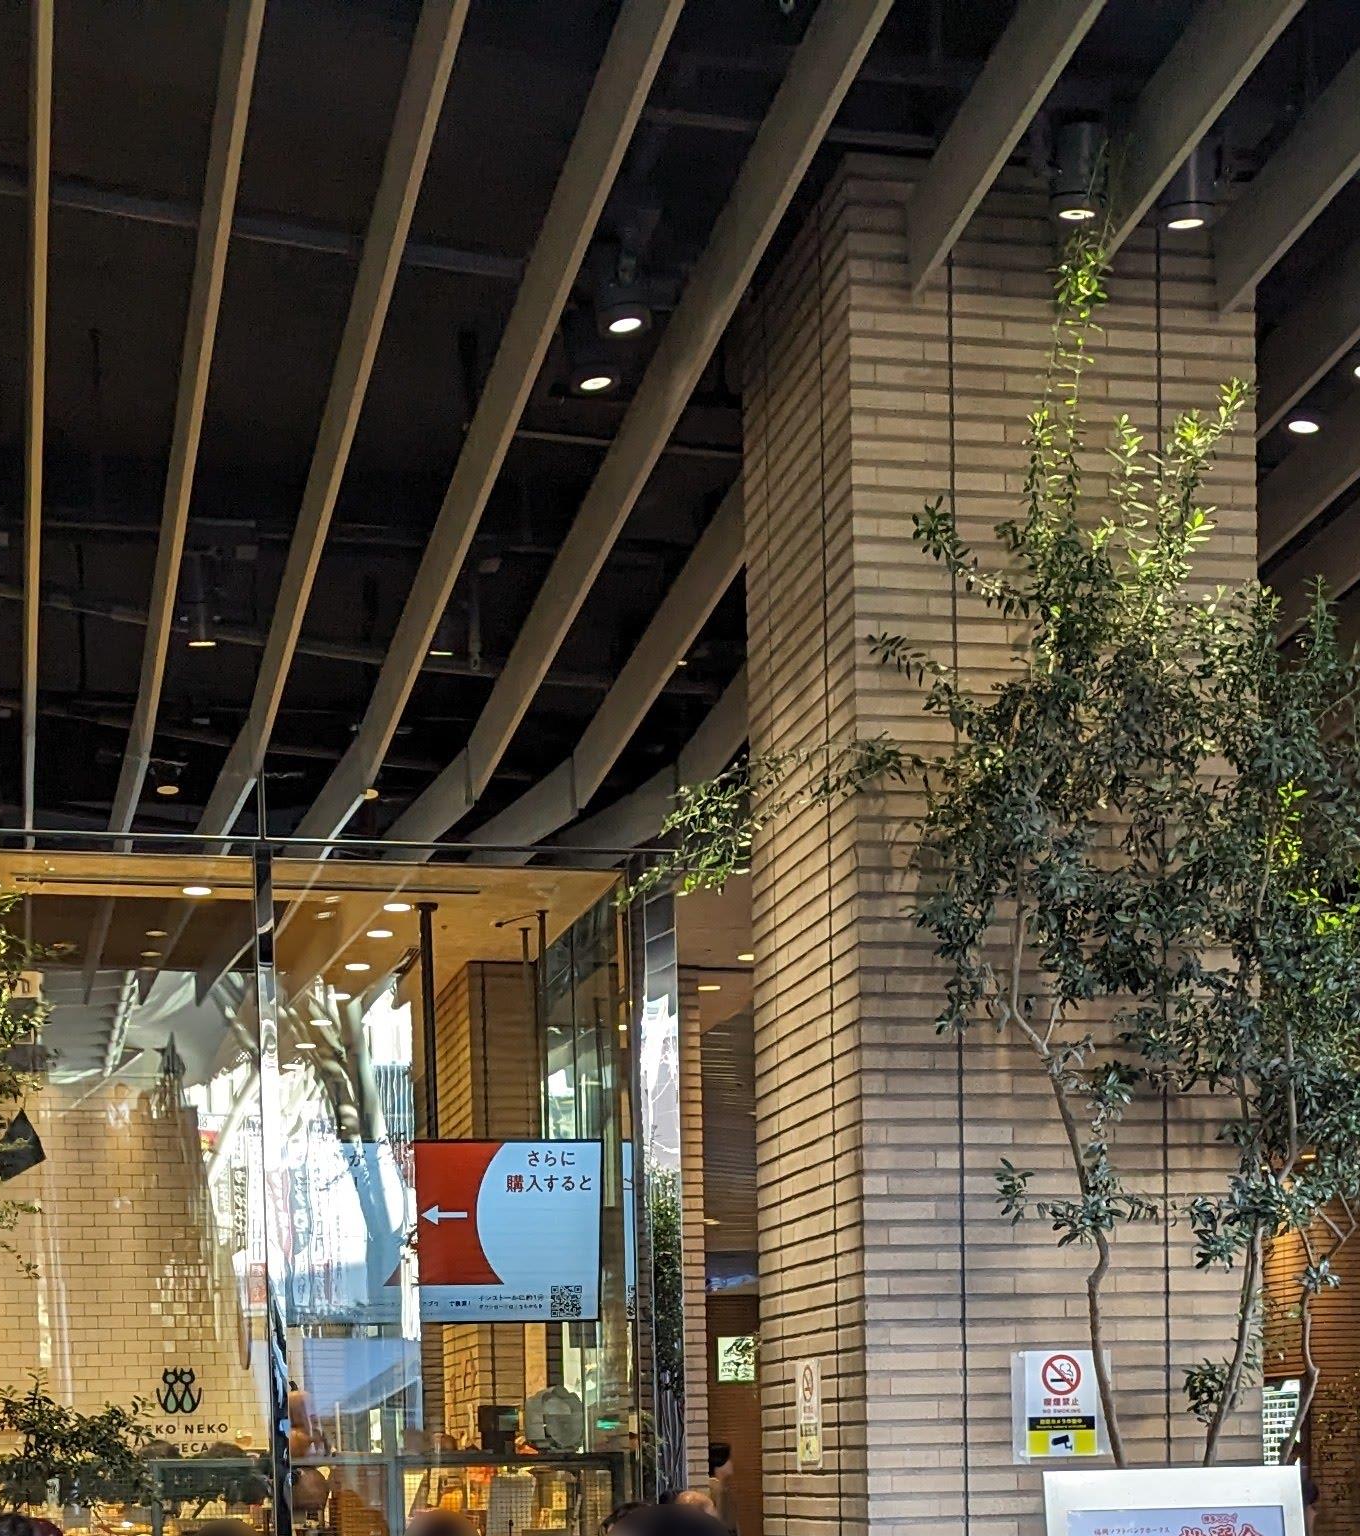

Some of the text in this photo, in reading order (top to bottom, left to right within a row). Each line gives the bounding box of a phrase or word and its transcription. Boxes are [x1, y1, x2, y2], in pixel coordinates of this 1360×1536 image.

[526, 1151, 575, 1167] さらに
[506, 1174, 592, 1193] 購入すると
[184, 1423, 228, 1434] NEKO
